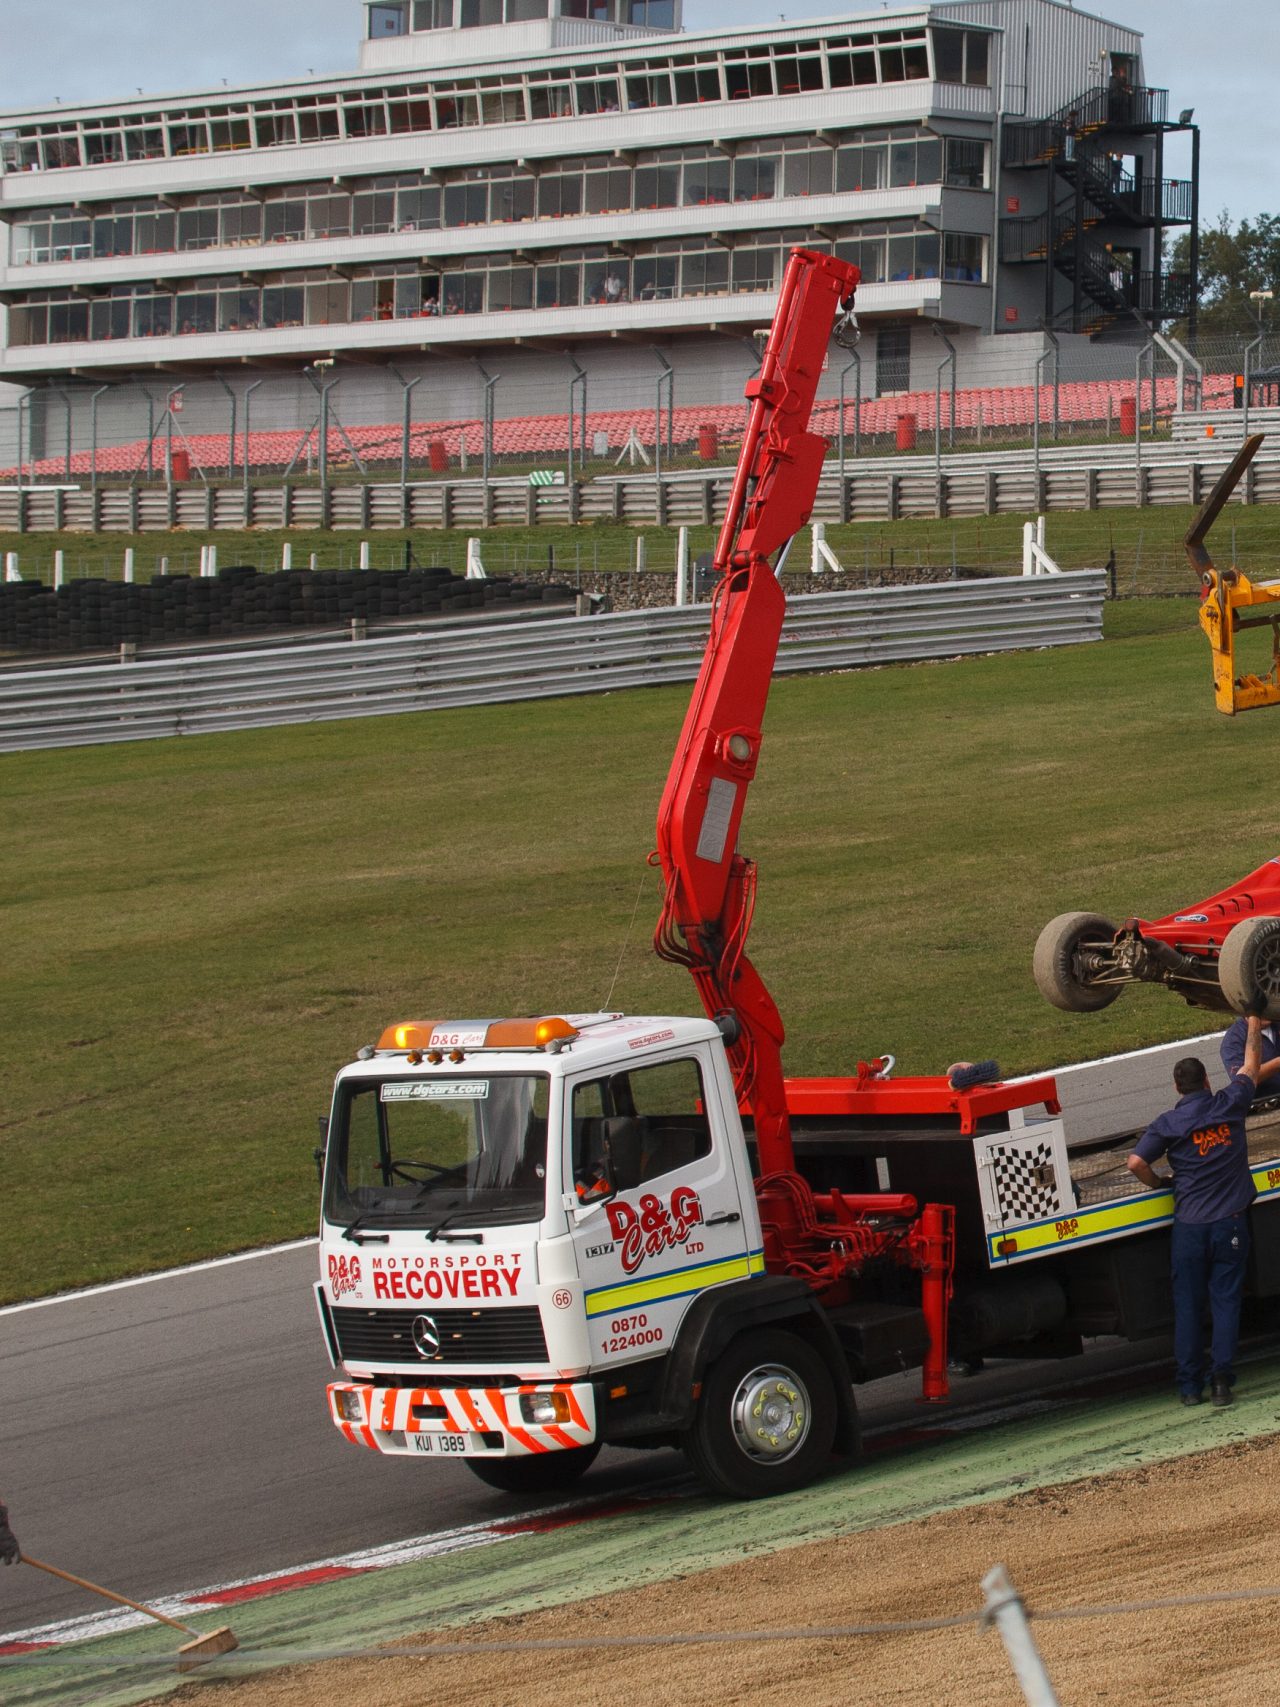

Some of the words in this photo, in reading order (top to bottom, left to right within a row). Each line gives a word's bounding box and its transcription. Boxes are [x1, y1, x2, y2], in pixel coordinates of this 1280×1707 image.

[431, 1035, 459, 1045] D&G
[383, 1083, 486, 1097] www.dgcars.com
[1192, 1123, 1231, 1144] D&G
[605, 1186, 704, 1243] D&G
[1056, 1218, 1078, 1232] D&G
[621, 1217, 695, 1275] Cars
[685, 1242, 704, 1255] LTD
[328, 1255, 362, 1281] D&G
[372, 1254, 521, 1268] MOTORSPORT
[332, 1271, 356, 1301] Cars
[373, 1268, 521, 1299] RECOVERY
[555, 1292, 569, 1306] 66
[612, 1314, 647, 1333] 0870
[602, 1328, 663, 1354] 1224000
[415, 1435, 433, 1451] KUI
[439, 1436, 465, 1452] 1389
